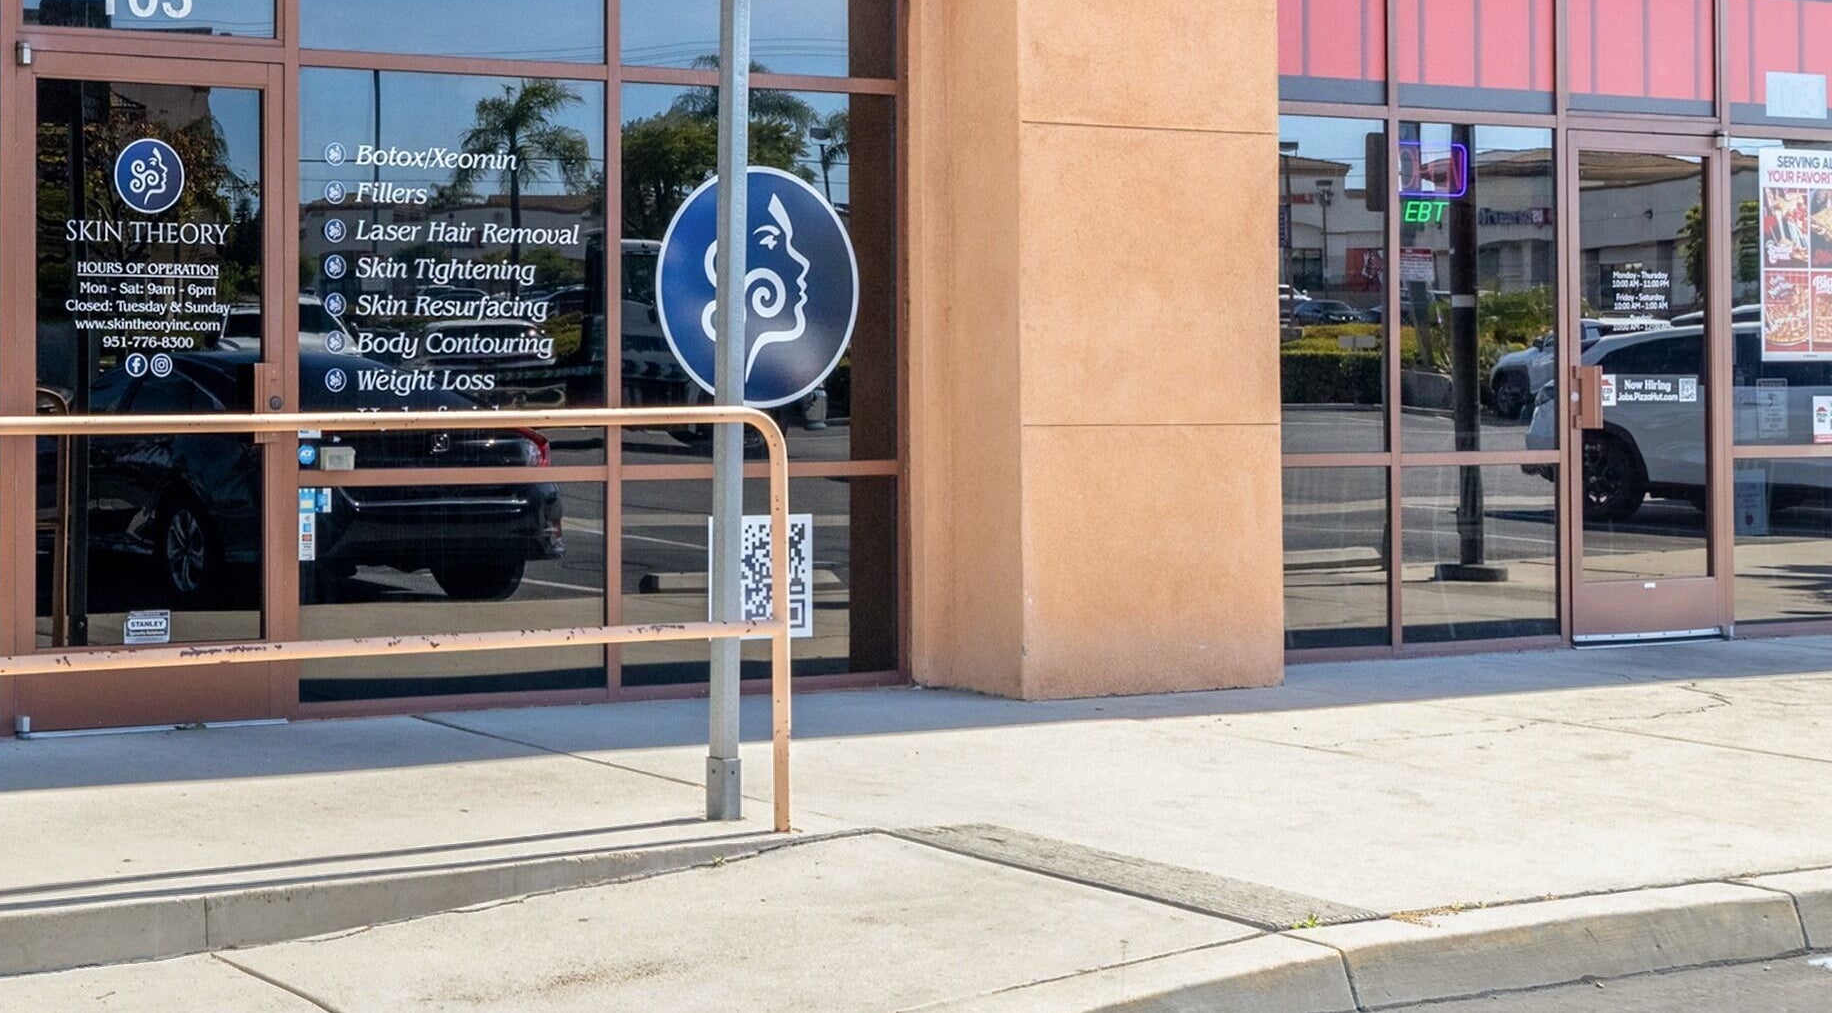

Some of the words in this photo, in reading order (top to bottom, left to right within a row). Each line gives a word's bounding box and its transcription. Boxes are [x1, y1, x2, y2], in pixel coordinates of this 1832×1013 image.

[355, 144, 518, 171] Botox/Xeomin
[1777, 155, 1821, 170] SERVING
[1767, 170, 1795, 183] YOUR
[1796, 171, 1832, 185] FAVORI
[355, 182, 428, 205] Fillers
[1404, 201, 1450, 222] EBT
[65, 219, 123, 242] SKIN
[129, 221, 231, 246] THEORY
[356, 219, 422, 242] Laser
[426, 221, 476, 243] Hair
[480, 223, 580, 245] Removal
[77, 261, 123, 275] HOURS
[125, 262, 145, 275] OF
[147, 263, 219, 276] OPERATION
[355, 257, 408, 279] Skin
[414, 257, 536, 286] Tightening
[1612, 271, 1636, 281] Monday
[1641, 271, 1668, 280] Thursday
[79, 281, 108, 294] Mon
[119, 282, 144, 295] Sat:
[147, 284, 175, 295] 9am
[187, 283, 217, 298] 6pm
[1629, 280, 1639, 288] AM
[1616, 293, 1635, 302] Friday
[1639, 293, 1665, 302] Saturday
[65, 299, 113, 312] Closed:
[115, 301, 167, 315] Tuesday
[169, 301, 182, 314] &
[184, 301, 231, 315] Sunday
[355, 295, 408, 317] Skin
[414, 296, 549, 322] Resurfacing
[74, 318, 220, 333] www.skintheoryinc.com
[102, 336, 194, 349] 951-776-8300
[355, 333, 419, 359] Body
[425, 333, 554, 360] Contouring
[356, 370, 436, 396] Weight
[442, 370, 495, 391] Loss
[1624, 379, 1643, 390] Now
[1644, 379, 1671, 392] Hiring
[130, 620, 164, 628] STANLEY
